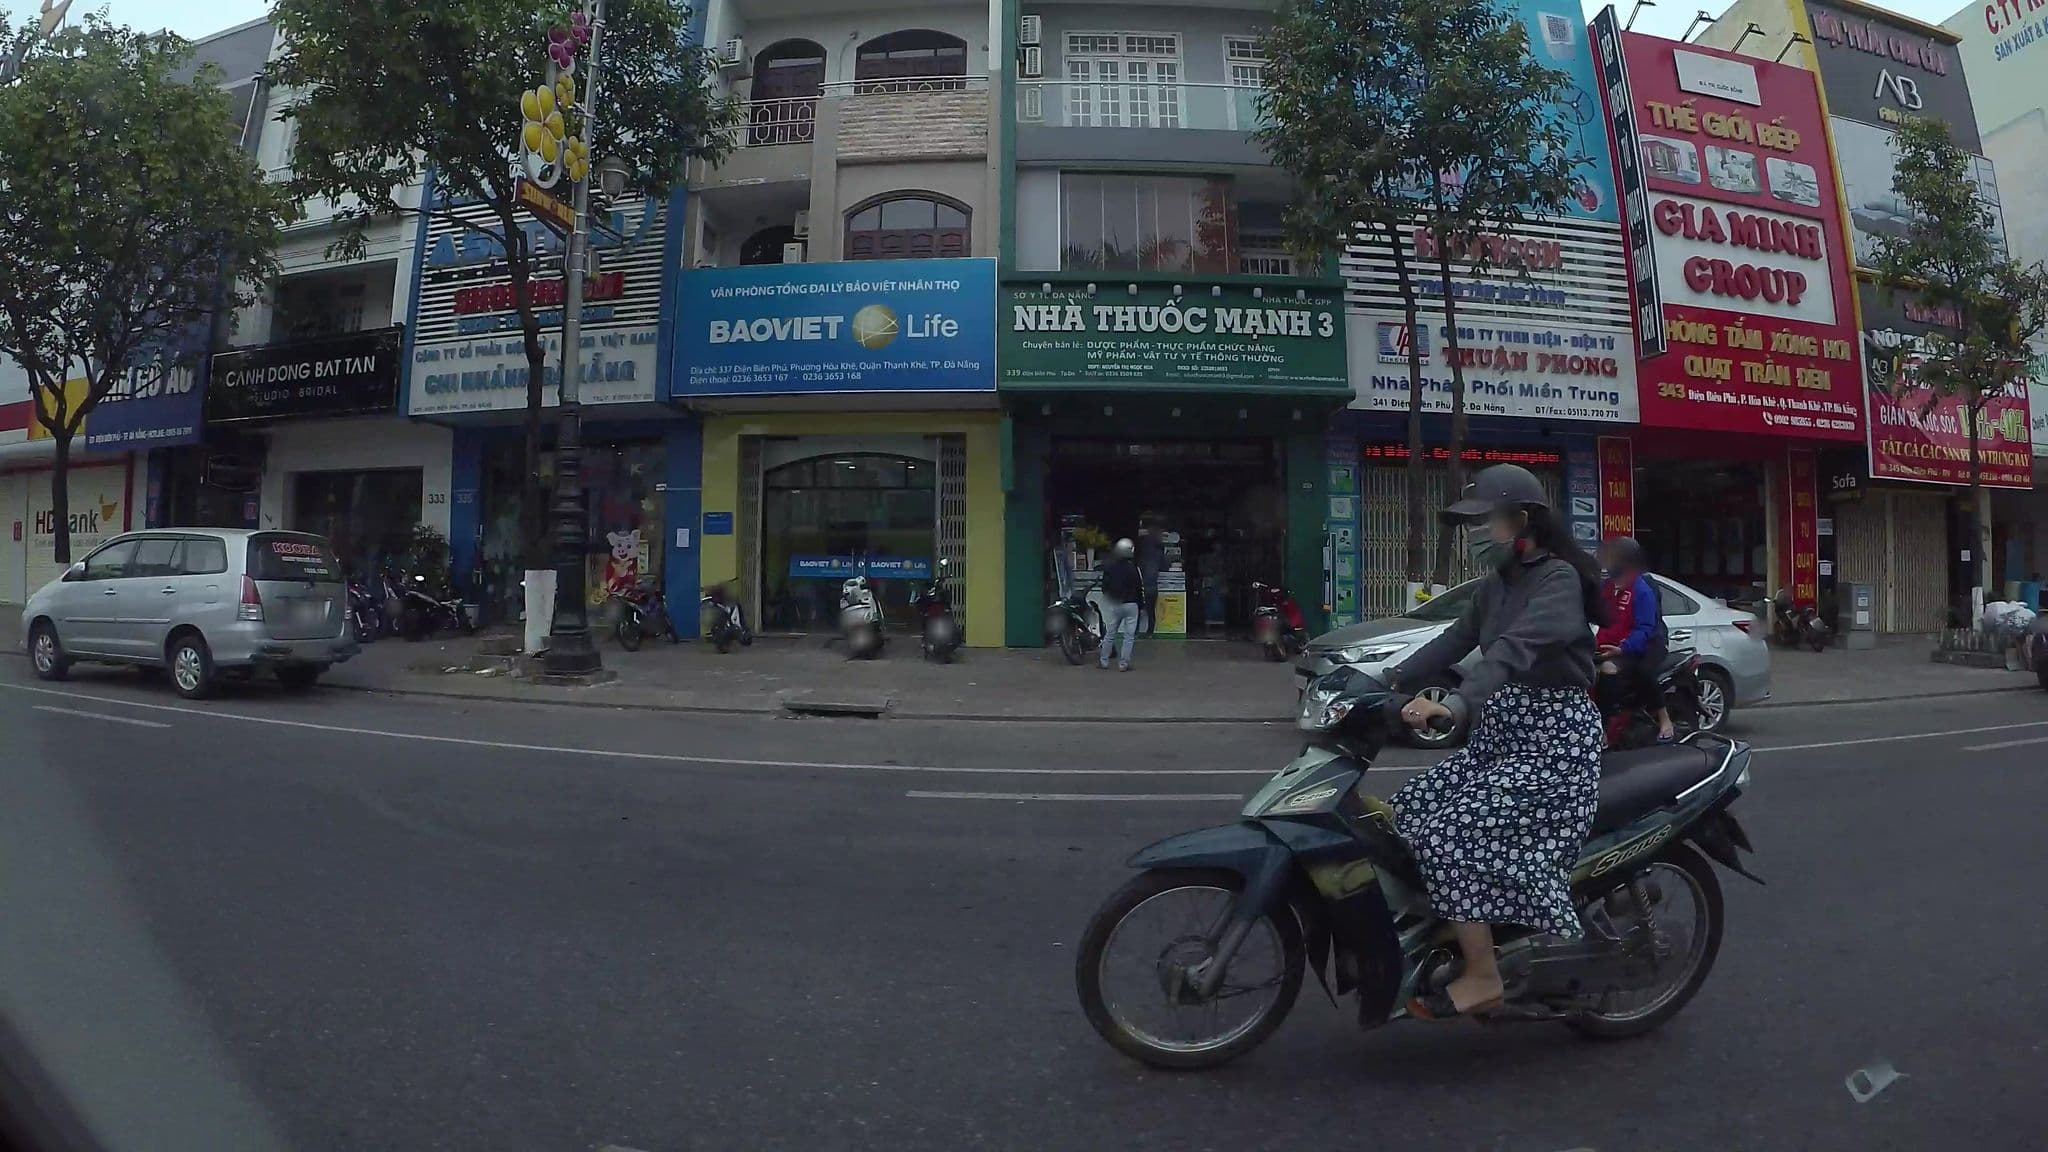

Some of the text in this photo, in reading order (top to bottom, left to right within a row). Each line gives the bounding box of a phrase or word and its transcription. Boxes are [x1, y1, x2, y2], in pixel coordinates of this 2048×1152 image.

[2035, 22, 2044, 38] &
[1646, 98, 1800, 152] THẾ GIỚI BẾP
[1653, 199, 1823, 261] GIA MINH
[735, 286, 775, 298] PHÒNG
[777, 282, 808, 295] TỔNG
[809, 283, 829, 296] ĐẠI
[846, 280, 870, 293] BẢO
[872, 279, 896, 294] VIỆT
[899, 279, 933, 291] NHÂN
[935, 280, 960, 293] THỌ
[1684, 255, 1807, 306] GROUP
[1030, 291, 1036, 299] Y
[1013, 296, 1334, 339] NHÀ THUỐC MẠNH 3
[710, 313, 959, 344] BAOVIET Life
[1478, 329, 1493, 341] TY
[1664, 314, 1718, 346] HÒNG
[1022, 341, 1053, 350] Chuyên
[1204, 352, 1239, 362] THÔNG
[1442, 345, 1619, 378] THUẬN PHONG
[226, 355, 375, 387] CANH DONG BAT TAN
[719, 365, 732, 374] 337
[732, 374, 752, 383] 0236
[753, 374, 772, 382] 3653
[824, 372, 844, 381] 3653
[1006, 369, 1021, 377] 339
[1683, 355, 1733, 385] QUẠT
[1740, 354, 1791, 386] TRẦN
[299, 385, 337, 398] BRIDAL
[1372, 376, 1620, 405] Nhà Phối Miền Trung
[1657, 381, 1685, 399] 343
[1373, 398, 1388, 407] 341
[1880, 401, 1906, 426] GIẢM
[1833, 473, 1856, 489] Sofa
[428, 493, 445, 504] 333
